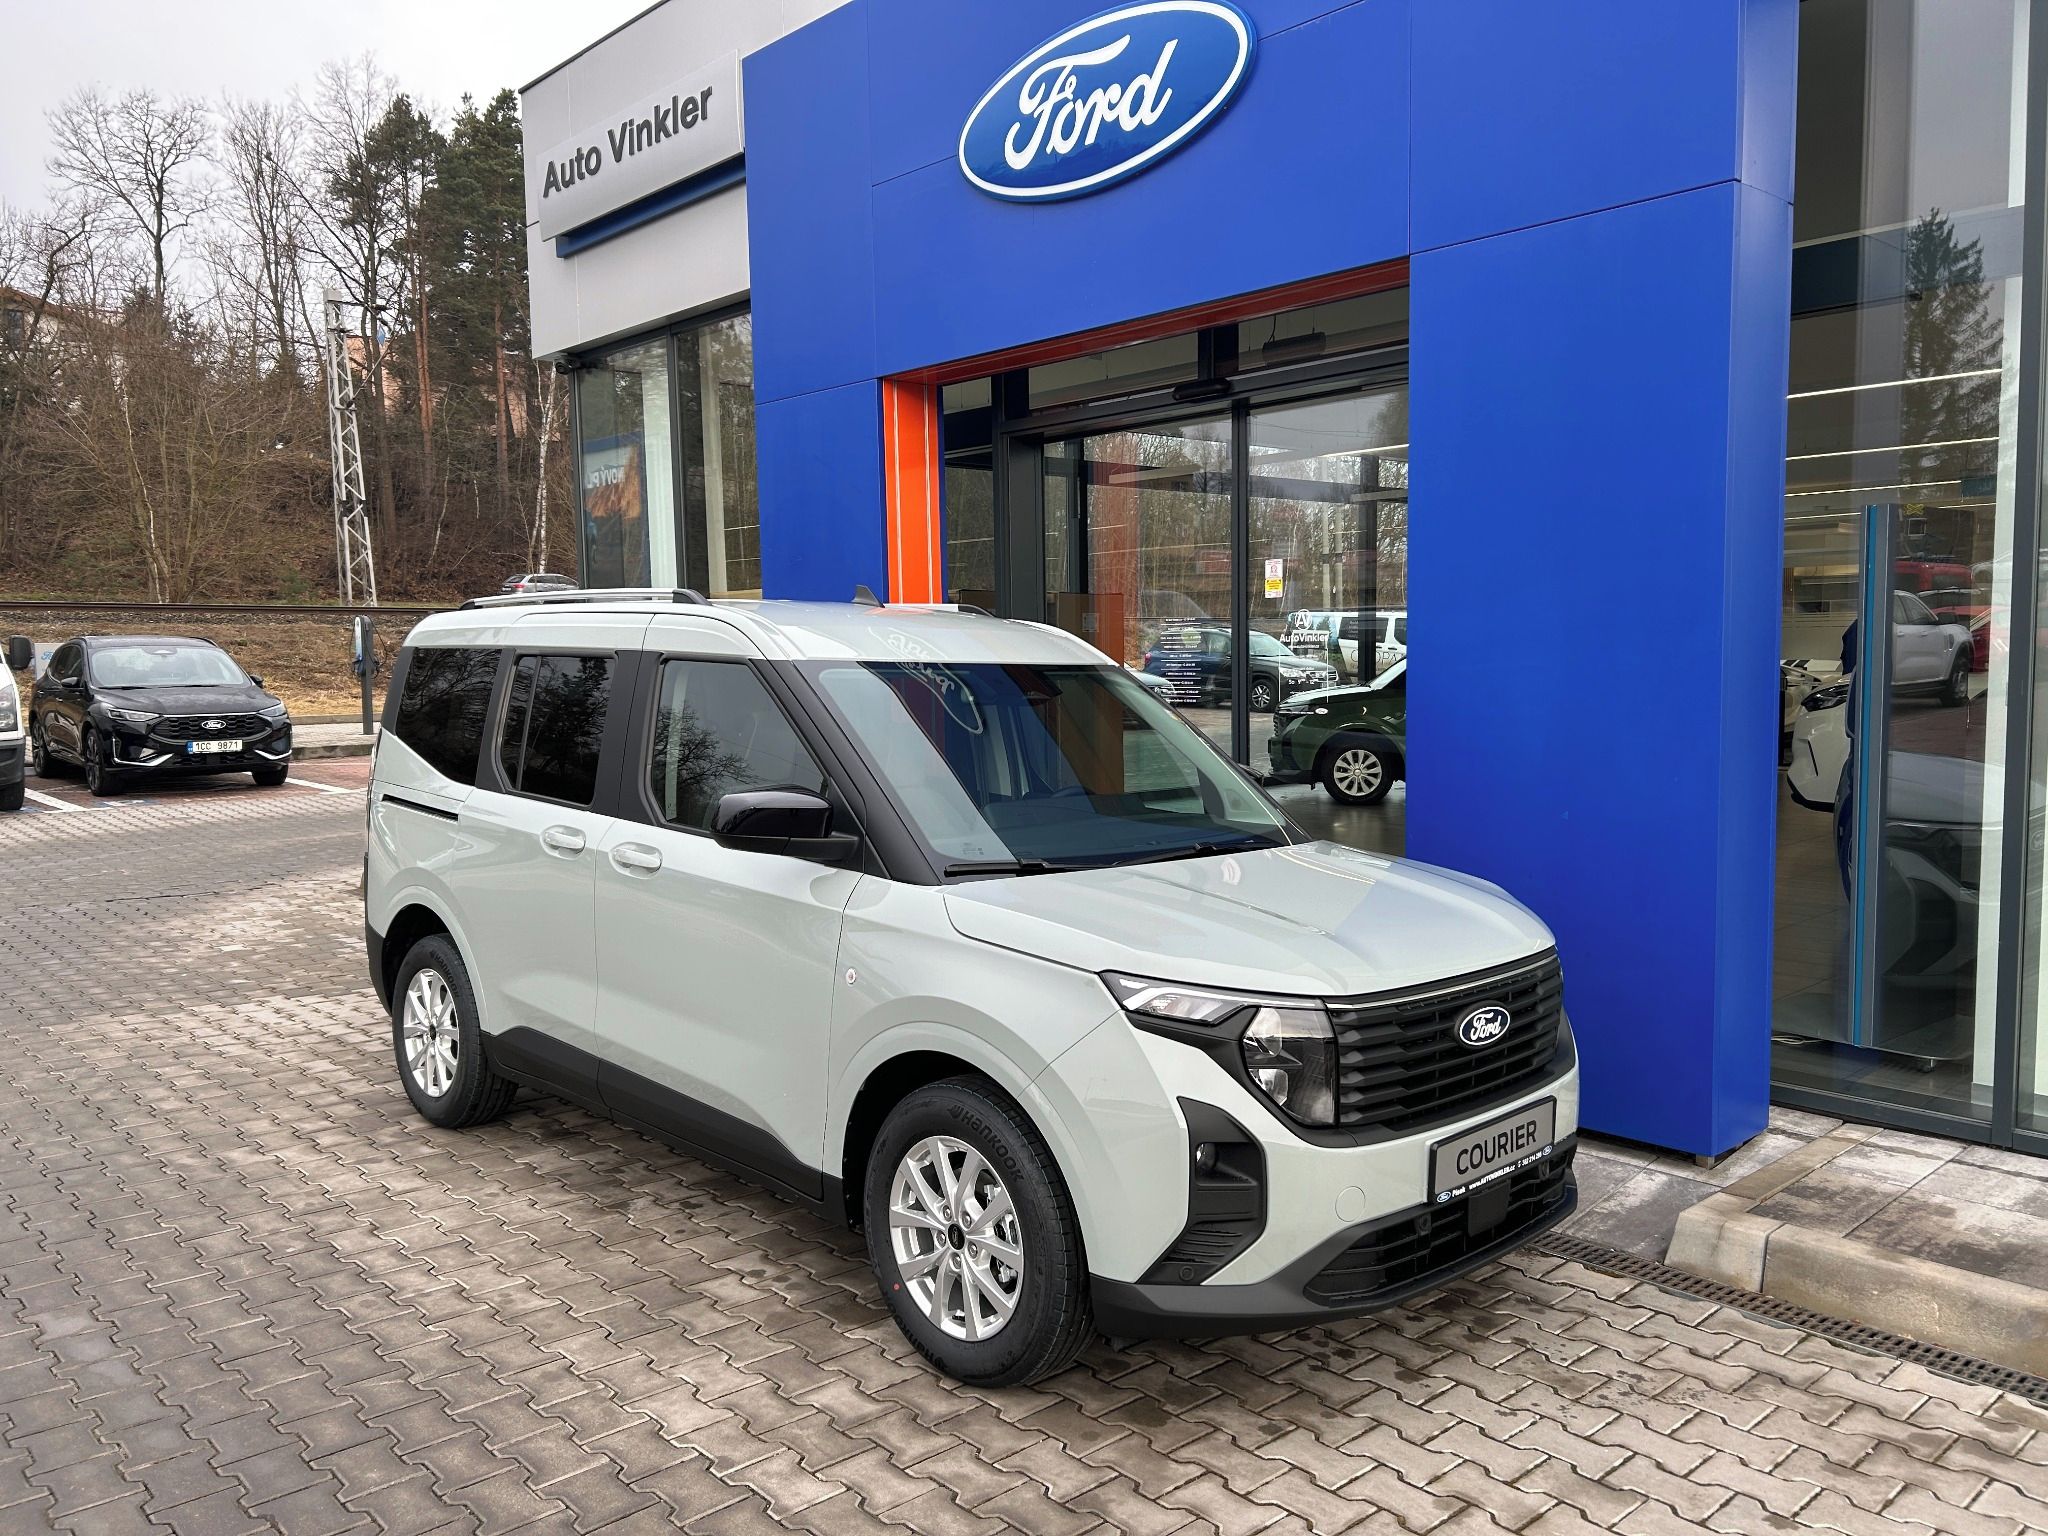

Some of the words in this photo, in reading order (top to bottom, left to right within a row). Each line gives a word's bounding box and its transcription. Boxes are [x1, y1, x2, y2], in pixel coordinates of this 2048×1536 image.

[1004, 34, 1179, 170] Ford
[542, 145, 602, 199] Auto
[607, 86, 713, 163] Vinkler
[195, 742, 212, 751] 1CC
[217, 741, 238, 750] 9871
[1470, 1011, 1502, 1041] Ford
[1456, 1119, 1538, 1175] COURIER
